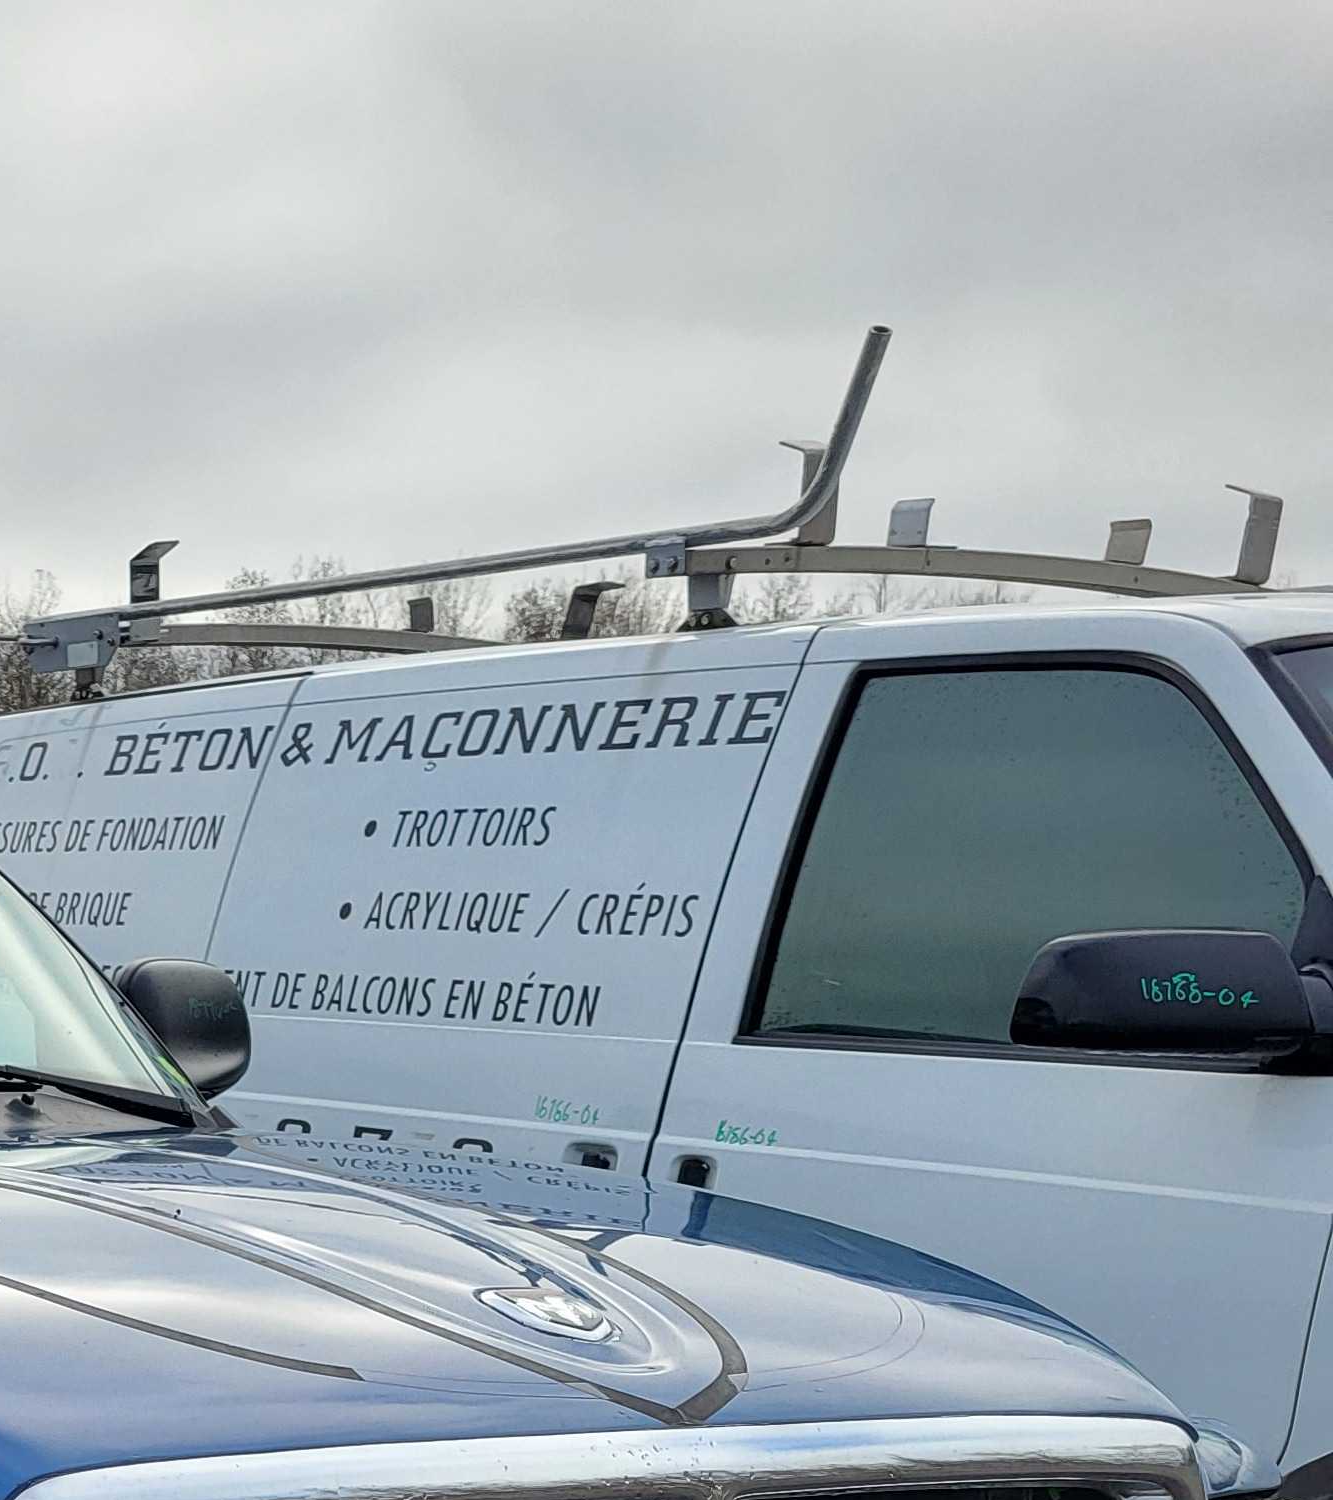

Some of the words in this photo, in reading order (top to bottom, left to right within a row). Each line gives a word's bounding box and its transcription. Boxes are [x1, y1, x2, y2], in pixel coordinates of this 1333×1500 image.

[103, 722, 275, 777] BÉTON
[280, 722, 314, 768] &
[324, 690, 788, 773] MAÇONNERIE
[64, 819, 96, 853] DE
[96, 815, 226, 852] FONDATION
[392, 806, 557, 848] TROTTOIRS
[54, 892, 132, 927] BRIQUE
[363, 891, 530, 934] ACRYLIQUE
[577, 883, 700, 938] CRÉPIS
[271, 972, 307, 1010] DE
[311, 973, 437, 1018] BALCONS
[443, 979, 486, 1020] EN
[491, 972, 602, 1028] BÉTON
